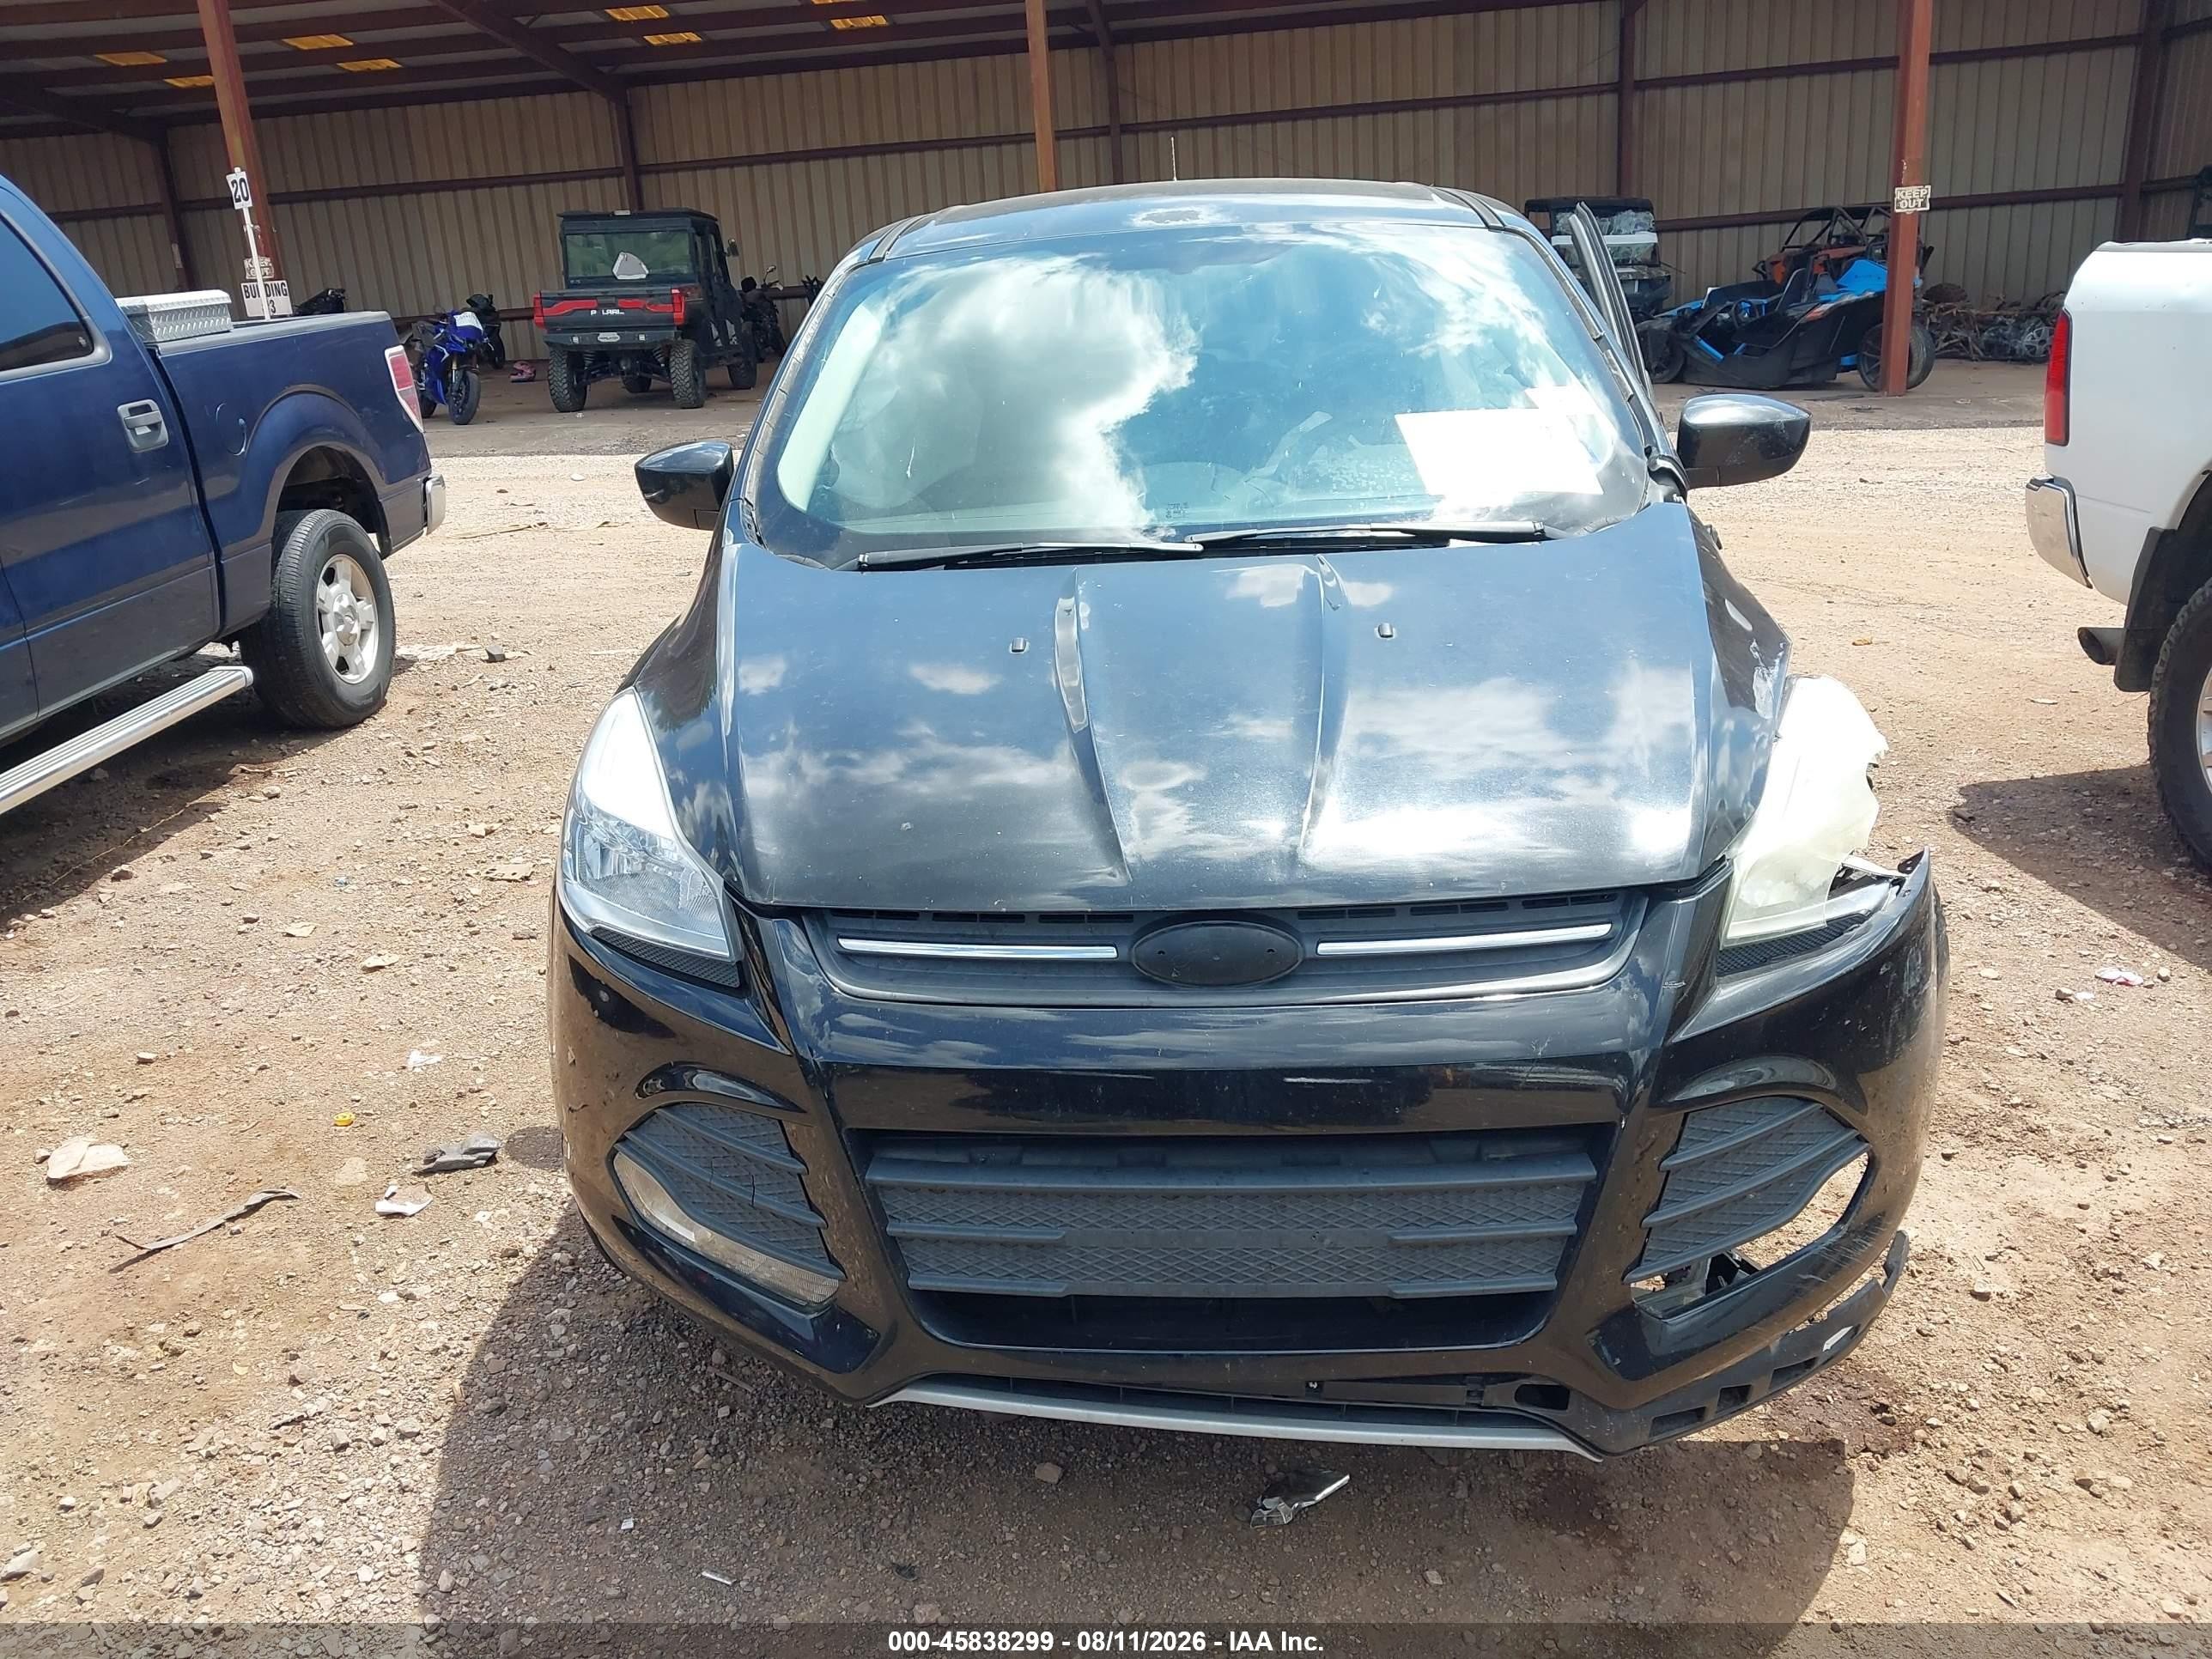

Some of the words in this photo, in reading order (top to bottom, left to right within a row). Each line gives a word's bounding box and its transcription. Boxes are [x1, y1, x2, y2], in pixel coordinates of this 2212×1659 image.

[231, 177, 250, 204] 20
[1897, 188, 1928, 200] KEEP
[1899, 198, 1924, 209] OUT
[243, 282, 288, 299] BUIDING
